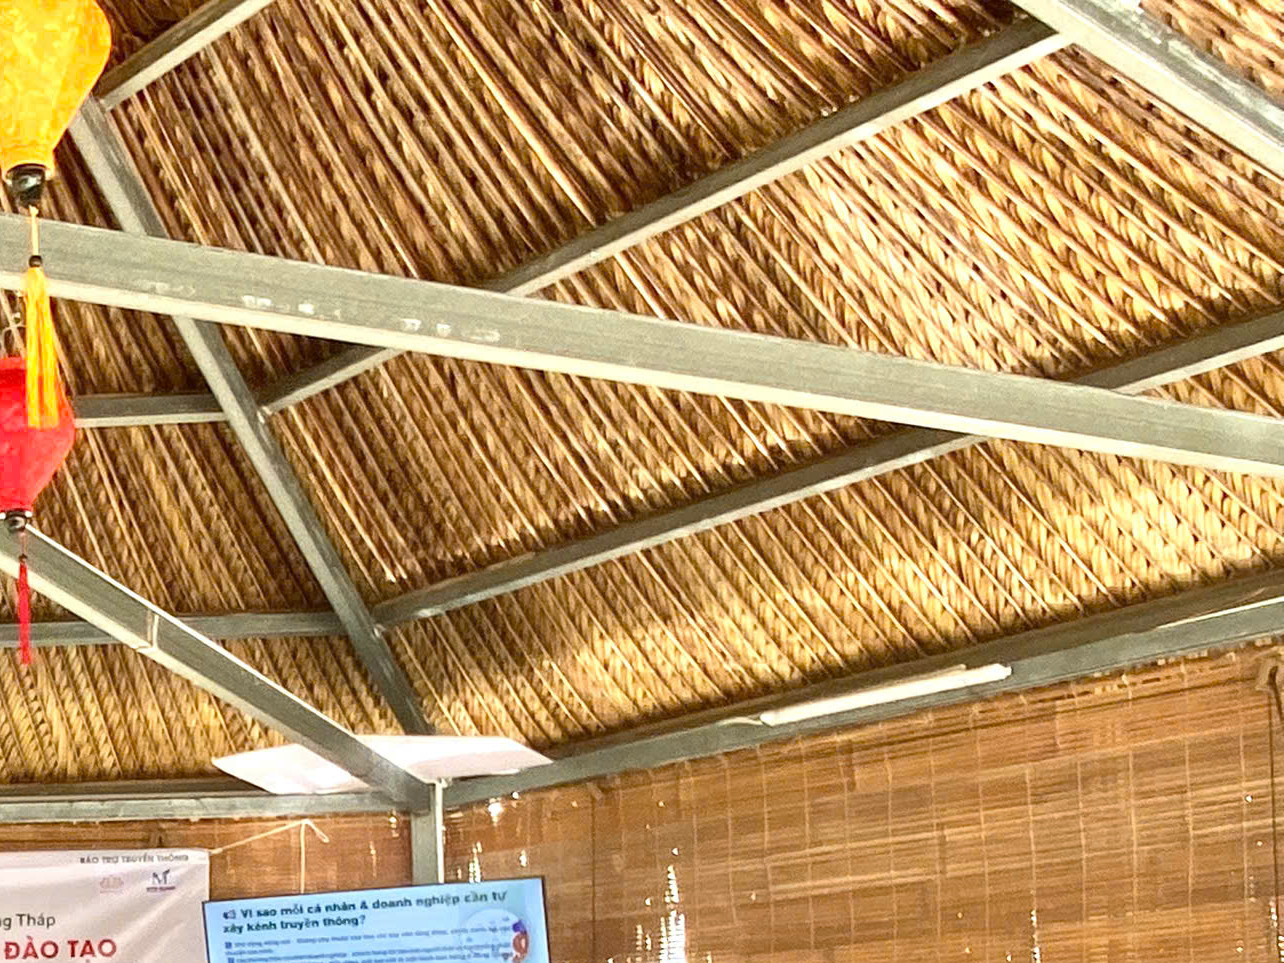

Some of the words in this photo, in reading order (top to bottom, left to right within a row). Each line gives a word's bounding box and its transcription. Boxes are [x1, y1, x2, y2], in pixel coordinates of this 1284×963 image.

[256, 908, 277, 918] sao
[307, 903, 321, 914] cá
[325, 901, 356, 912] nhân
[372, 898, 413, 910] doanh
[416, 893, 460, 908] nghiệp
[16, 912, 55, 929] Tháp
[247, 920, 277, 932] kênh
[280, 917, 319, 931] truyền
[322, 914, 366, 927] thông?
[4, 935, 59, 960] ĐÀO
[67, 938, 117, 963] TẠO
